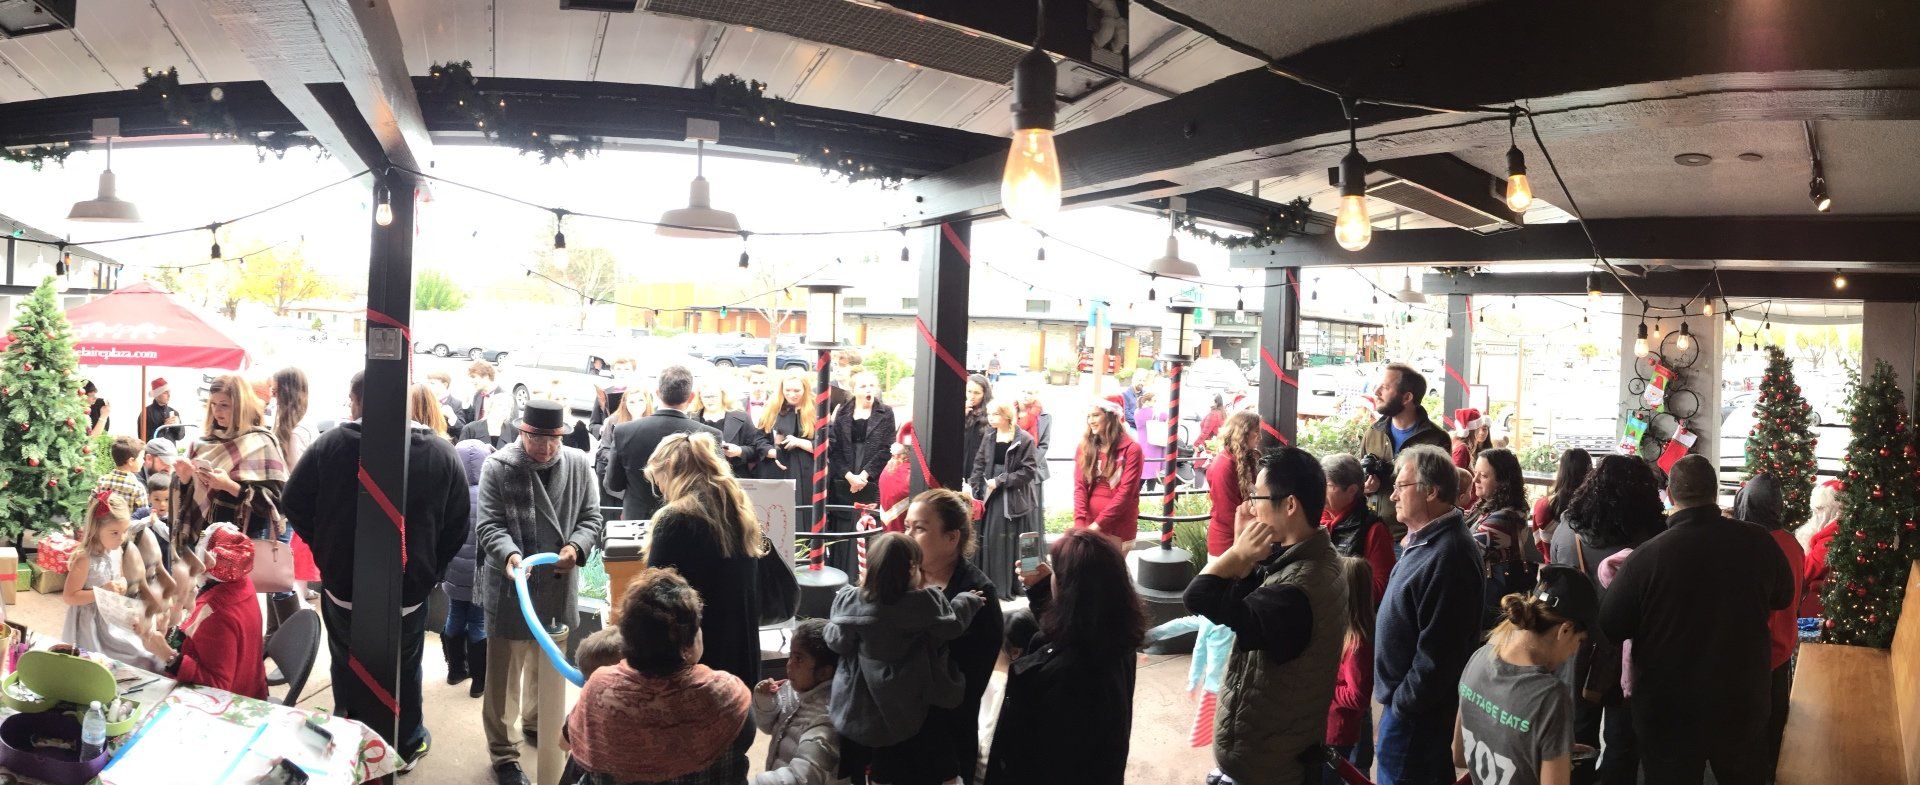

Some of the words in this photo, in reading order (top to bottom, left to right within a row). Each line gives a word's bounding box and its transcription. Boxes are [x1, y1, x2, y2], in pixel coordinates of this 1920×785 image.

[75, 347, 157, 359] elaireplaza.com
[1459, 682, 1498, 718] ERITAGE
[1500, 711, 1530, 732] EATS
